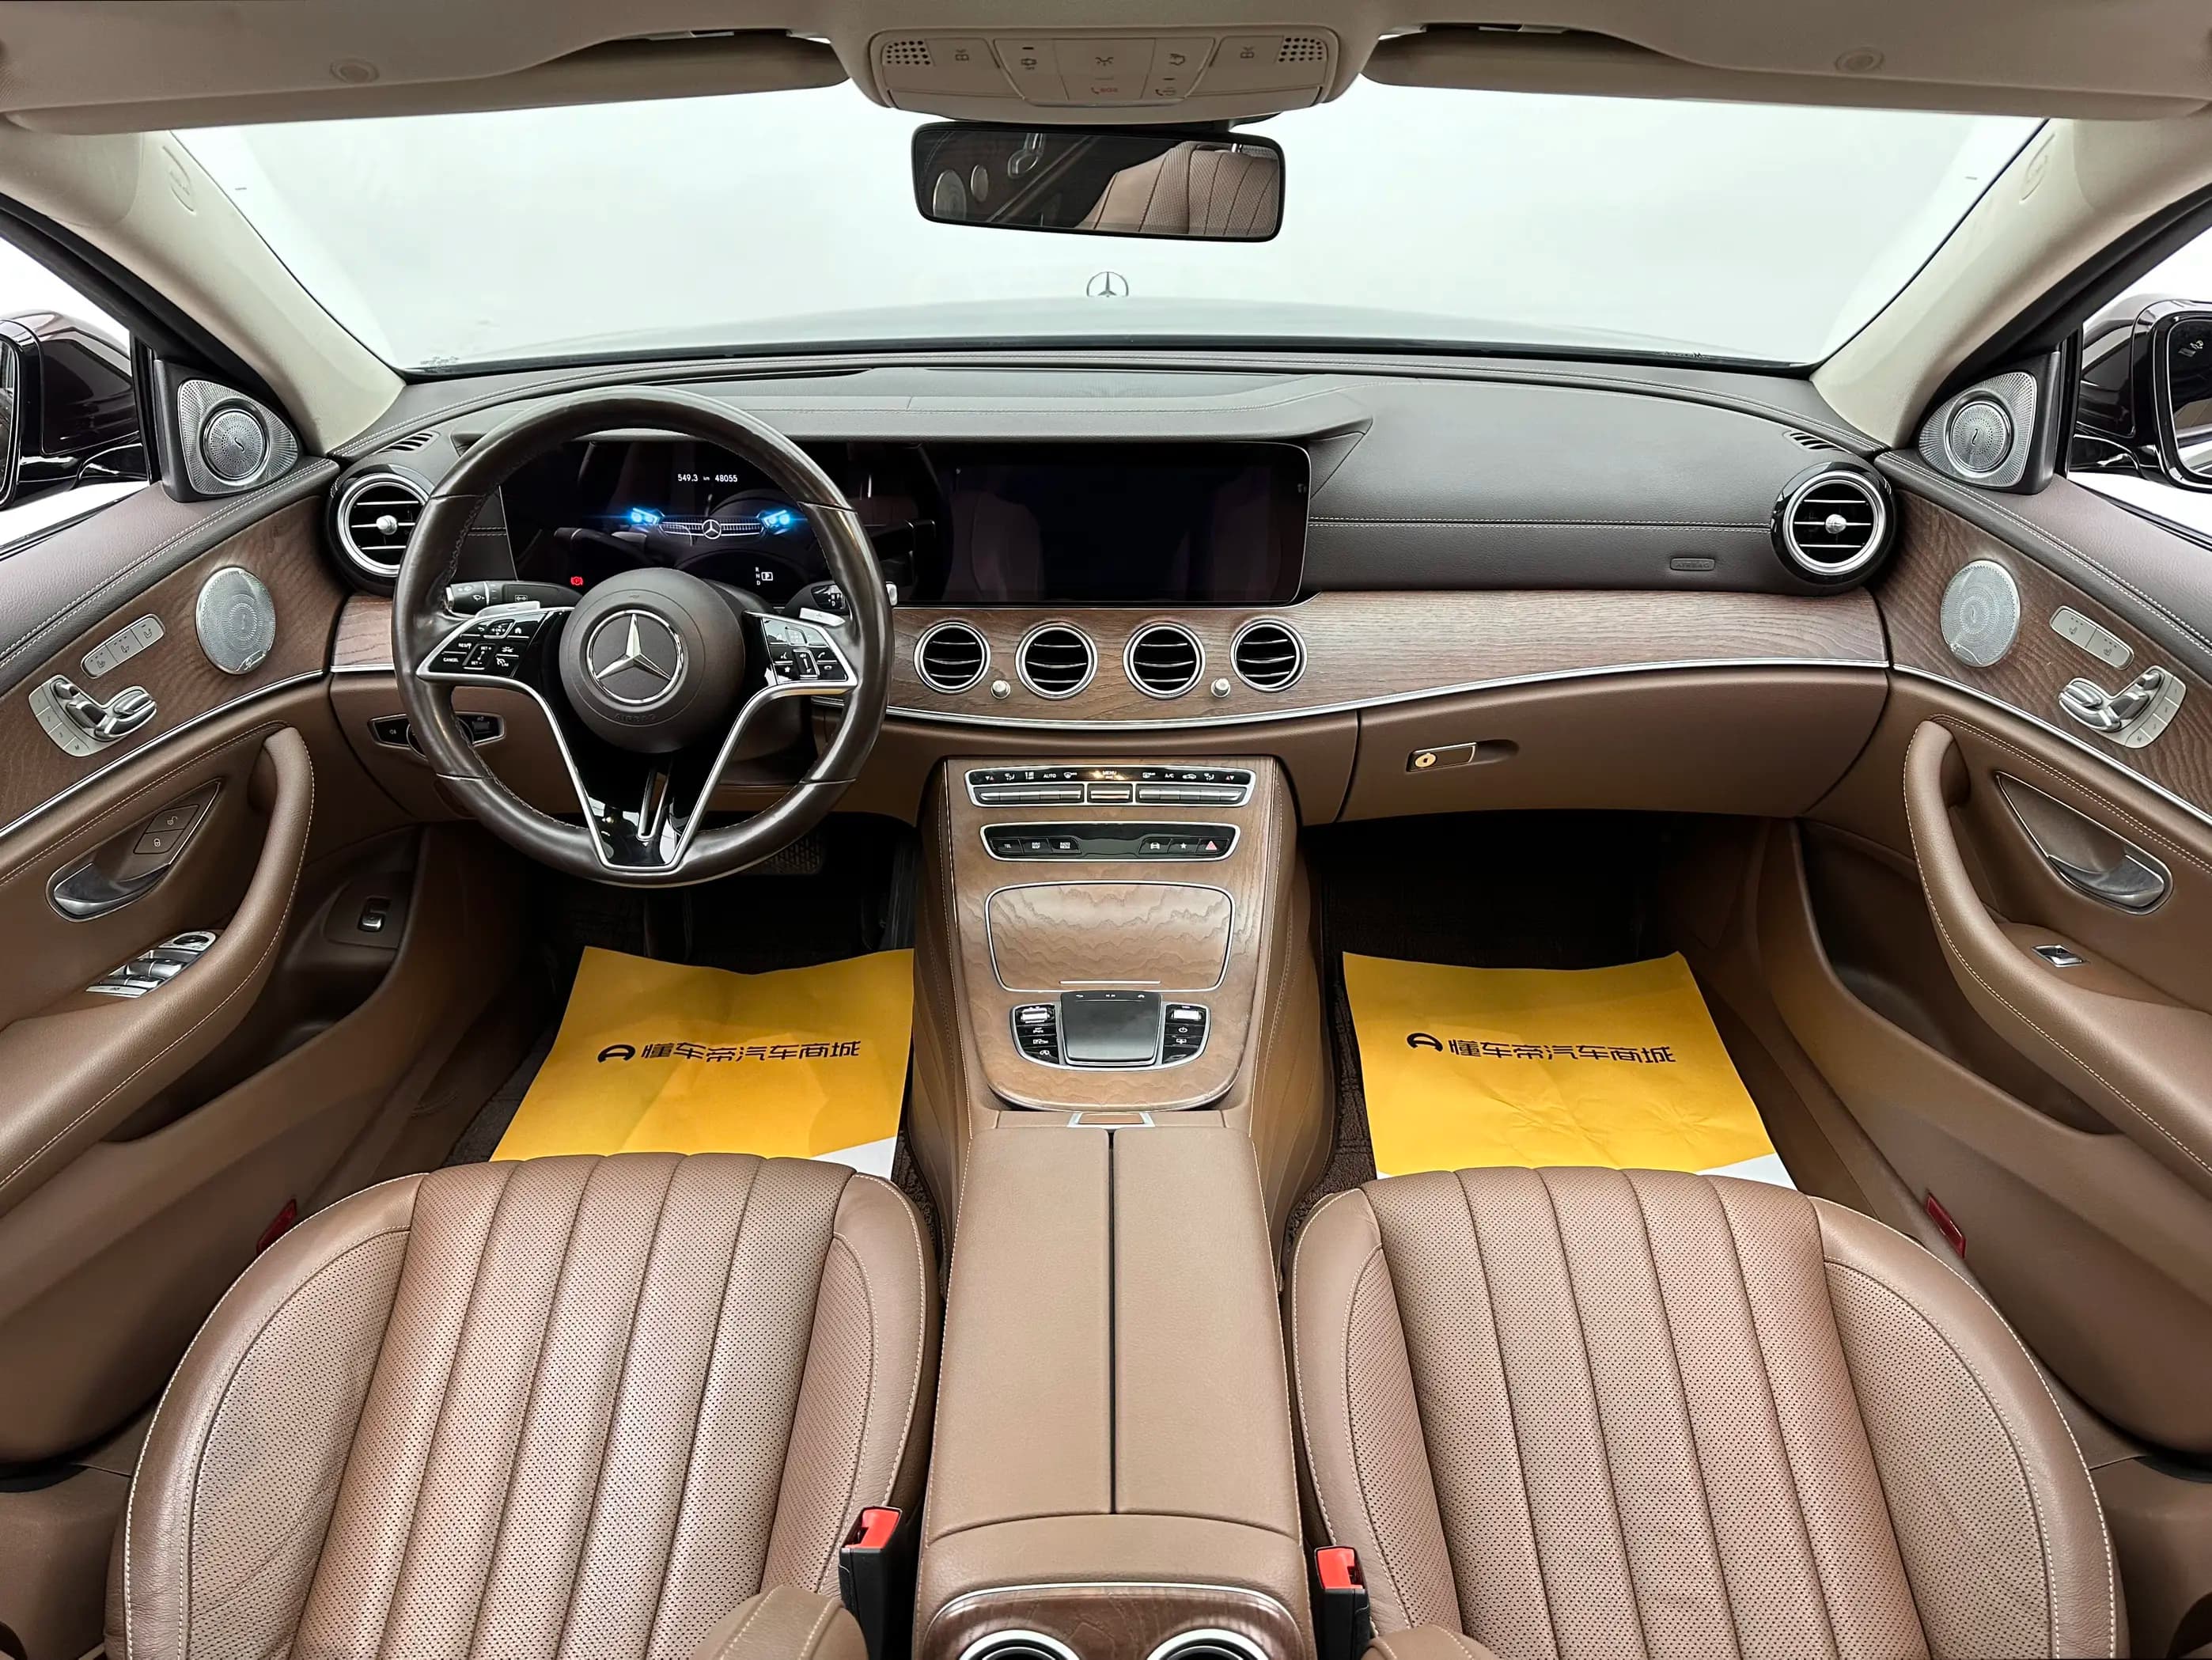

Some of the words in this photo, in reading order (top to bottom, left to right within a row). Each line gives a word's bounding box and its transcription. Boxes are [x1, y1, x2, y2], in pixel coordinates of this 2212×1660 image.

[677, 473, 698, 482] 549.3
[714, 474, 738, 483] 48055
[641, 1040, 862, 1063] 懂车帝汽车商城
[1448, 1038, 1677, 1064] 懂车帝汽车商城
